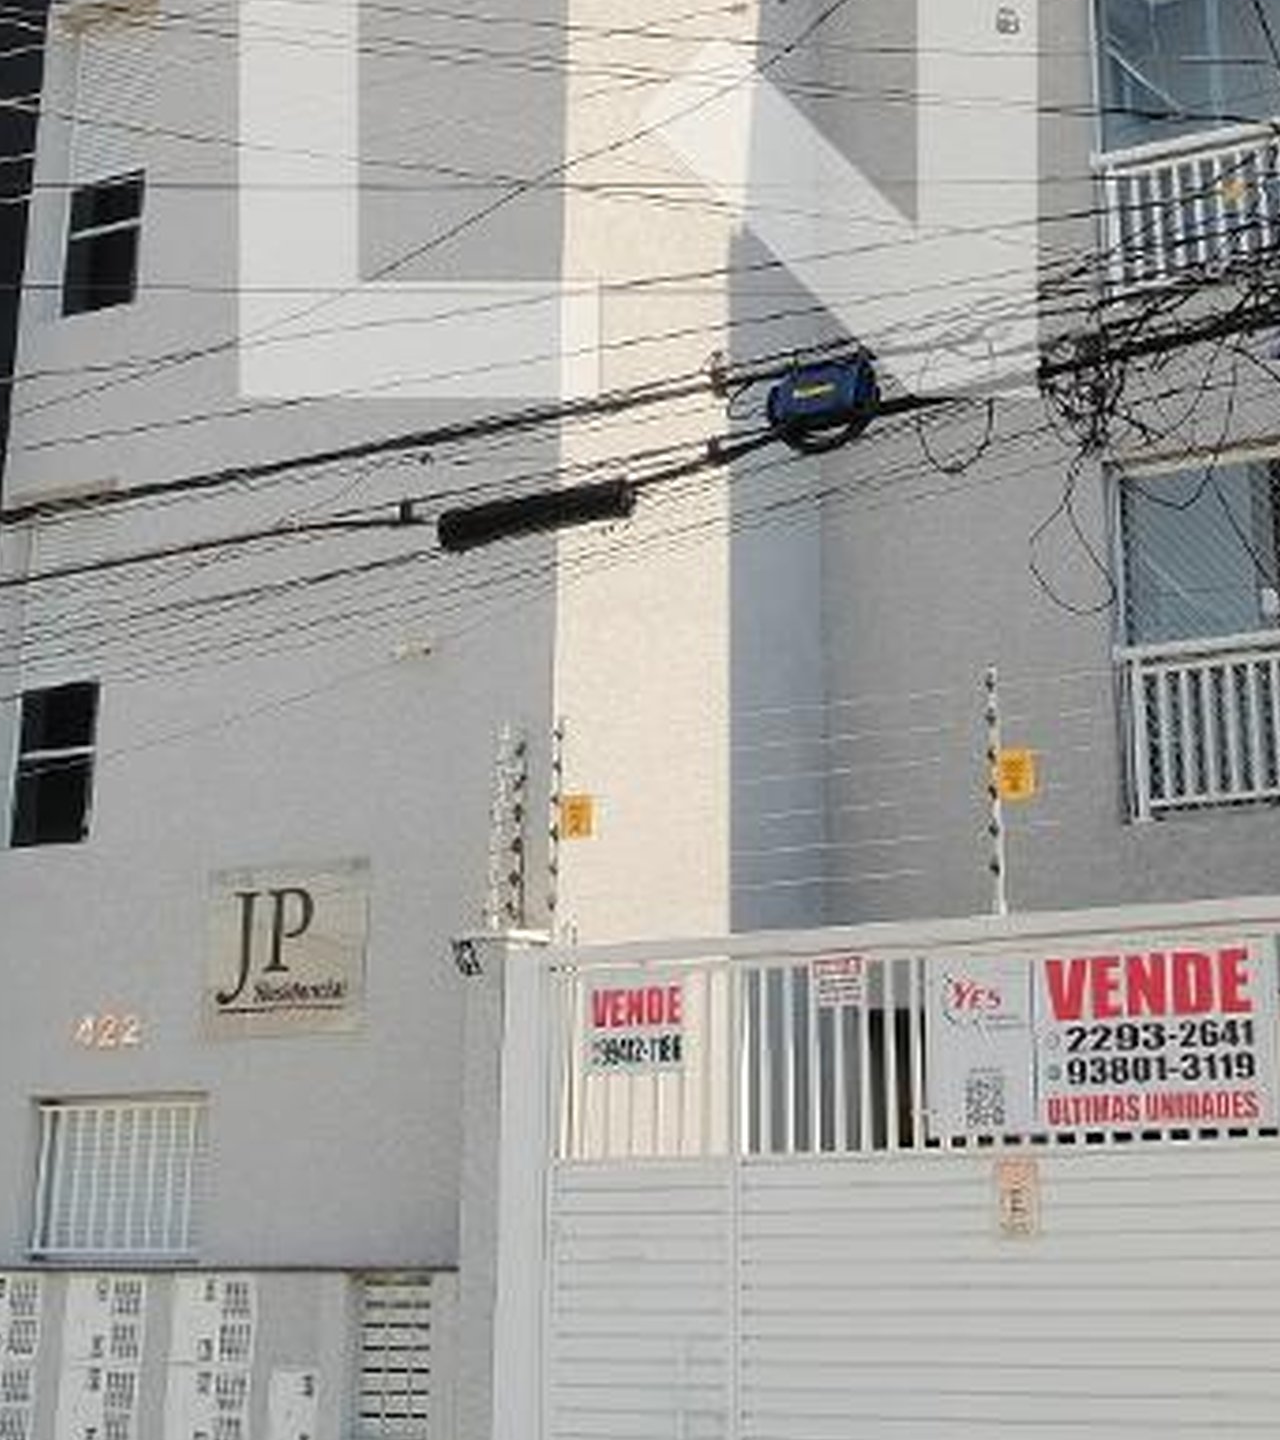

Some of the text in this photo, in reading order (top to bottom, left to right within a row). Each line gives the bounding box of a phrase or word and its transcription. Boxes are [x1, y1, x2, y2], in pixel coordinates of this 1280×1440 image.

[215, 887, 315, 1006] JP
[954, 981, 1001, 1010] YES
[1044, 948, 1252, 1021] VENDE
[593, 986, 681, 1028] VENDE
[1066, 1019, 1254, 1053] 2293-2641
[1066, 1052, 1257, 1086] 93801-3119
[1145, 1089, 1260, 1122] UNIDADES
